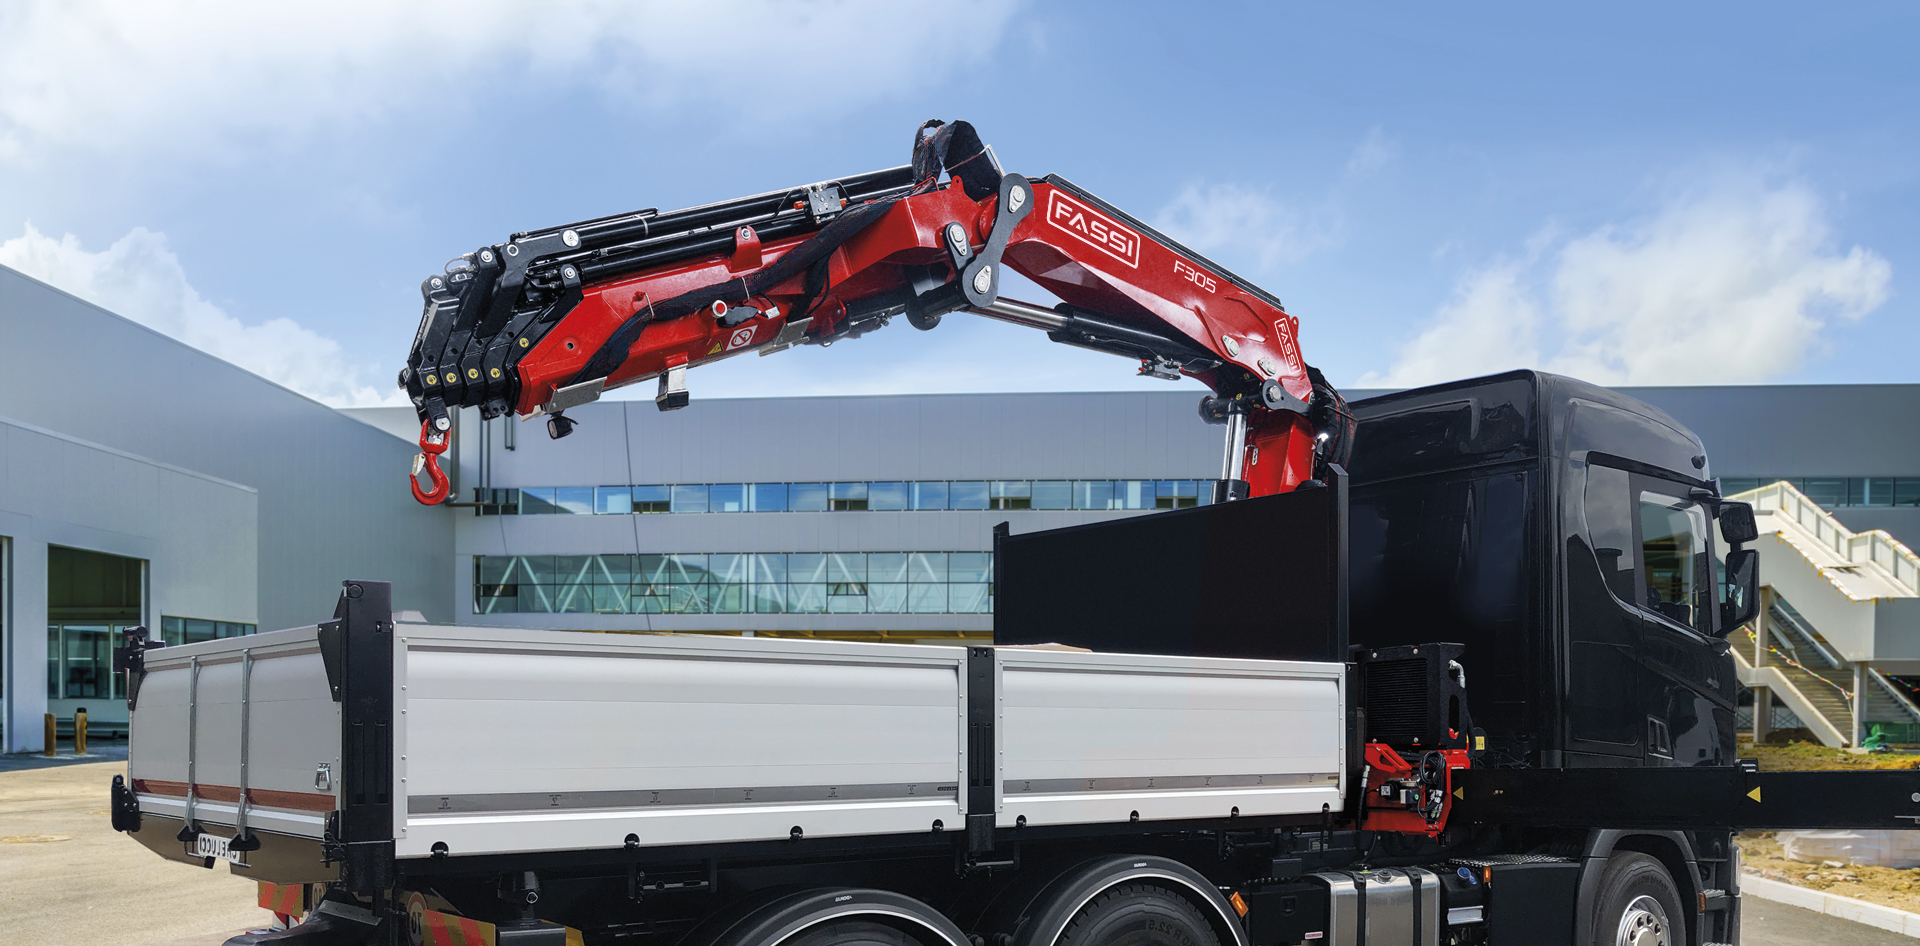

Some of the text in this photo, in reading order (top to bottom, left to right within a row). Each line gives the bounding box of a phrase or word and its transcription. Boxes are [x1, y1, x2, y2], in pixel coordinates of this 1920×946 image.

[1055, 201, 1133, 257] FASSI
[1173, 260, 1217, 293] F305
[1278, 323, 1298, 370] FASSI
